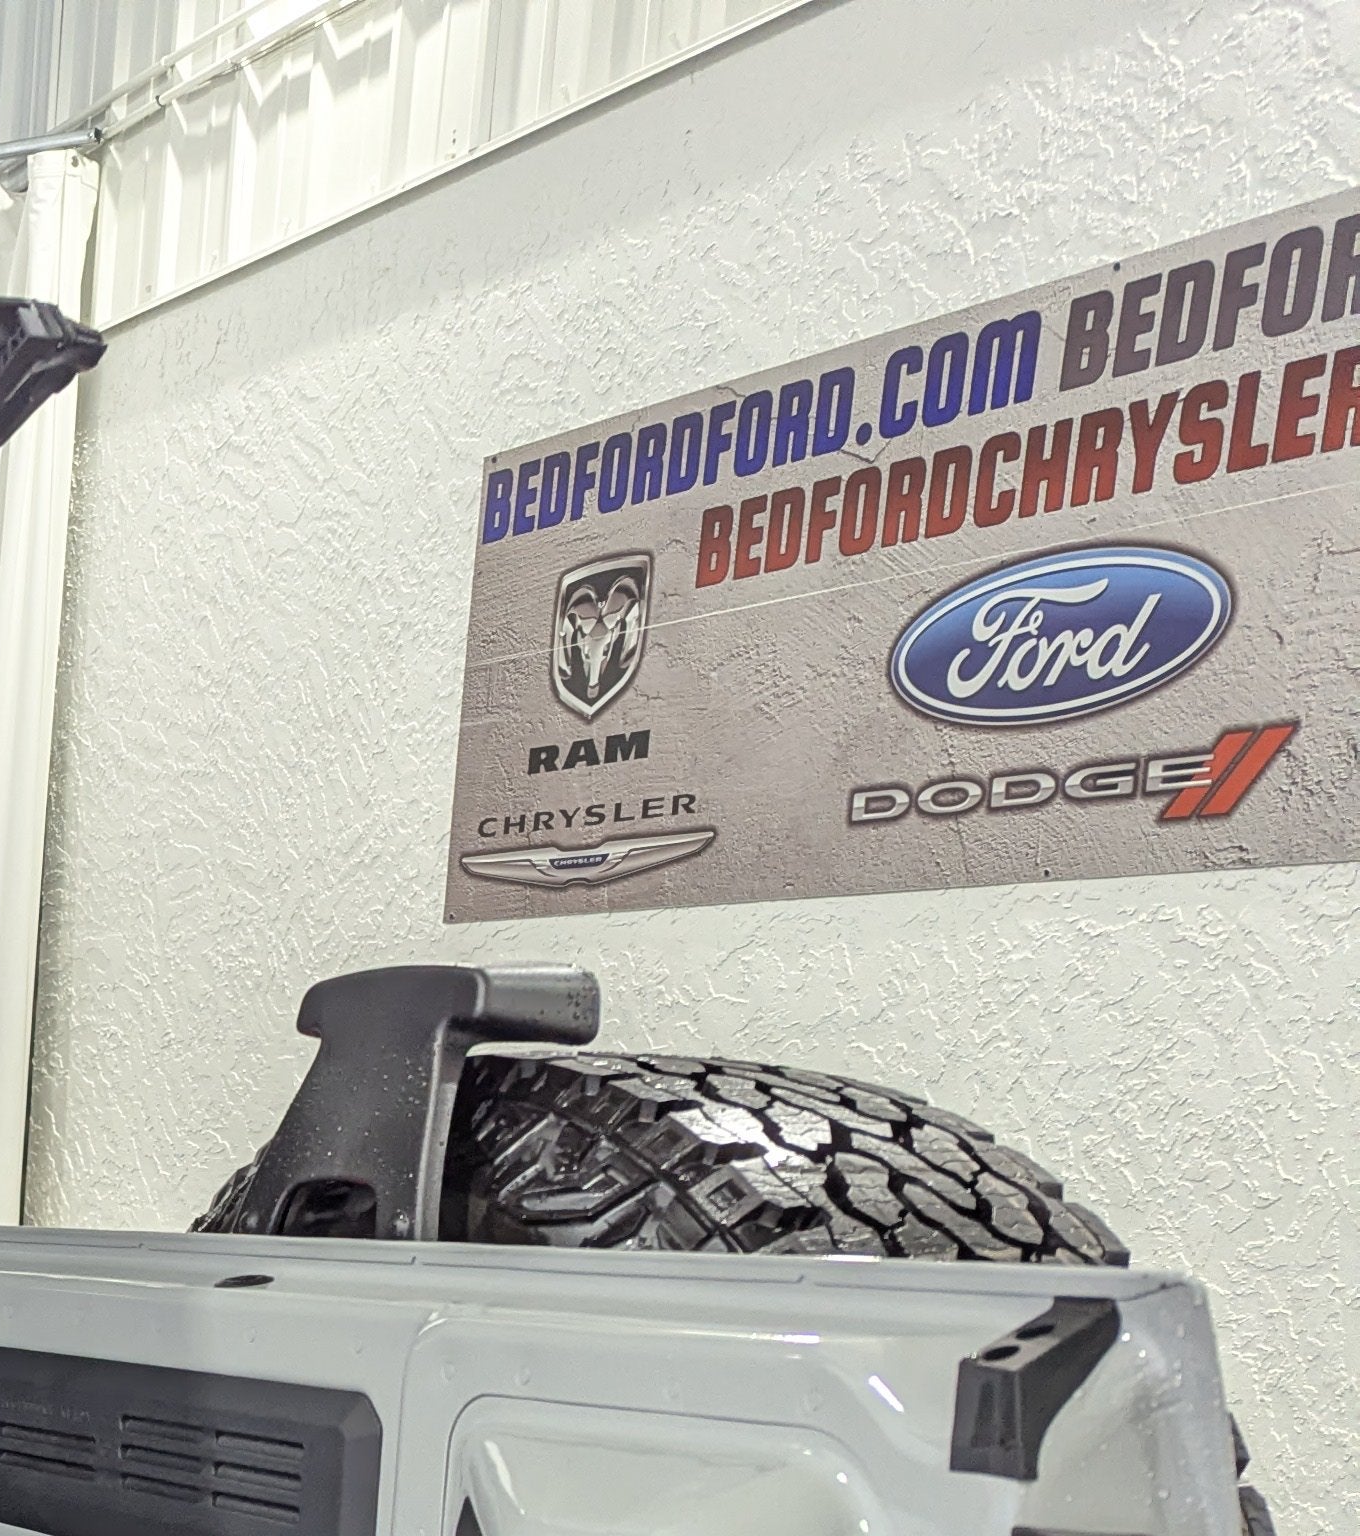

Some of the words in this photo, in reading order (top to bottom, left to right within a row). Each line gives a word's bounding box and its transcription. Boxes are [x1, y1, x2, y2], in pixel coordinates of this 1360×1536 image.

[481, 309, 1043, 544] BEDFORDFORD.COM
[946, 577, 1163, 699] Ford
[527, 729, 651, 776] RAM
[477, 793, 698, 838] CHRYSLER
[850, 753, 1216, 823] DODGE
[552, 856, 603, 867] CHRYSLER
